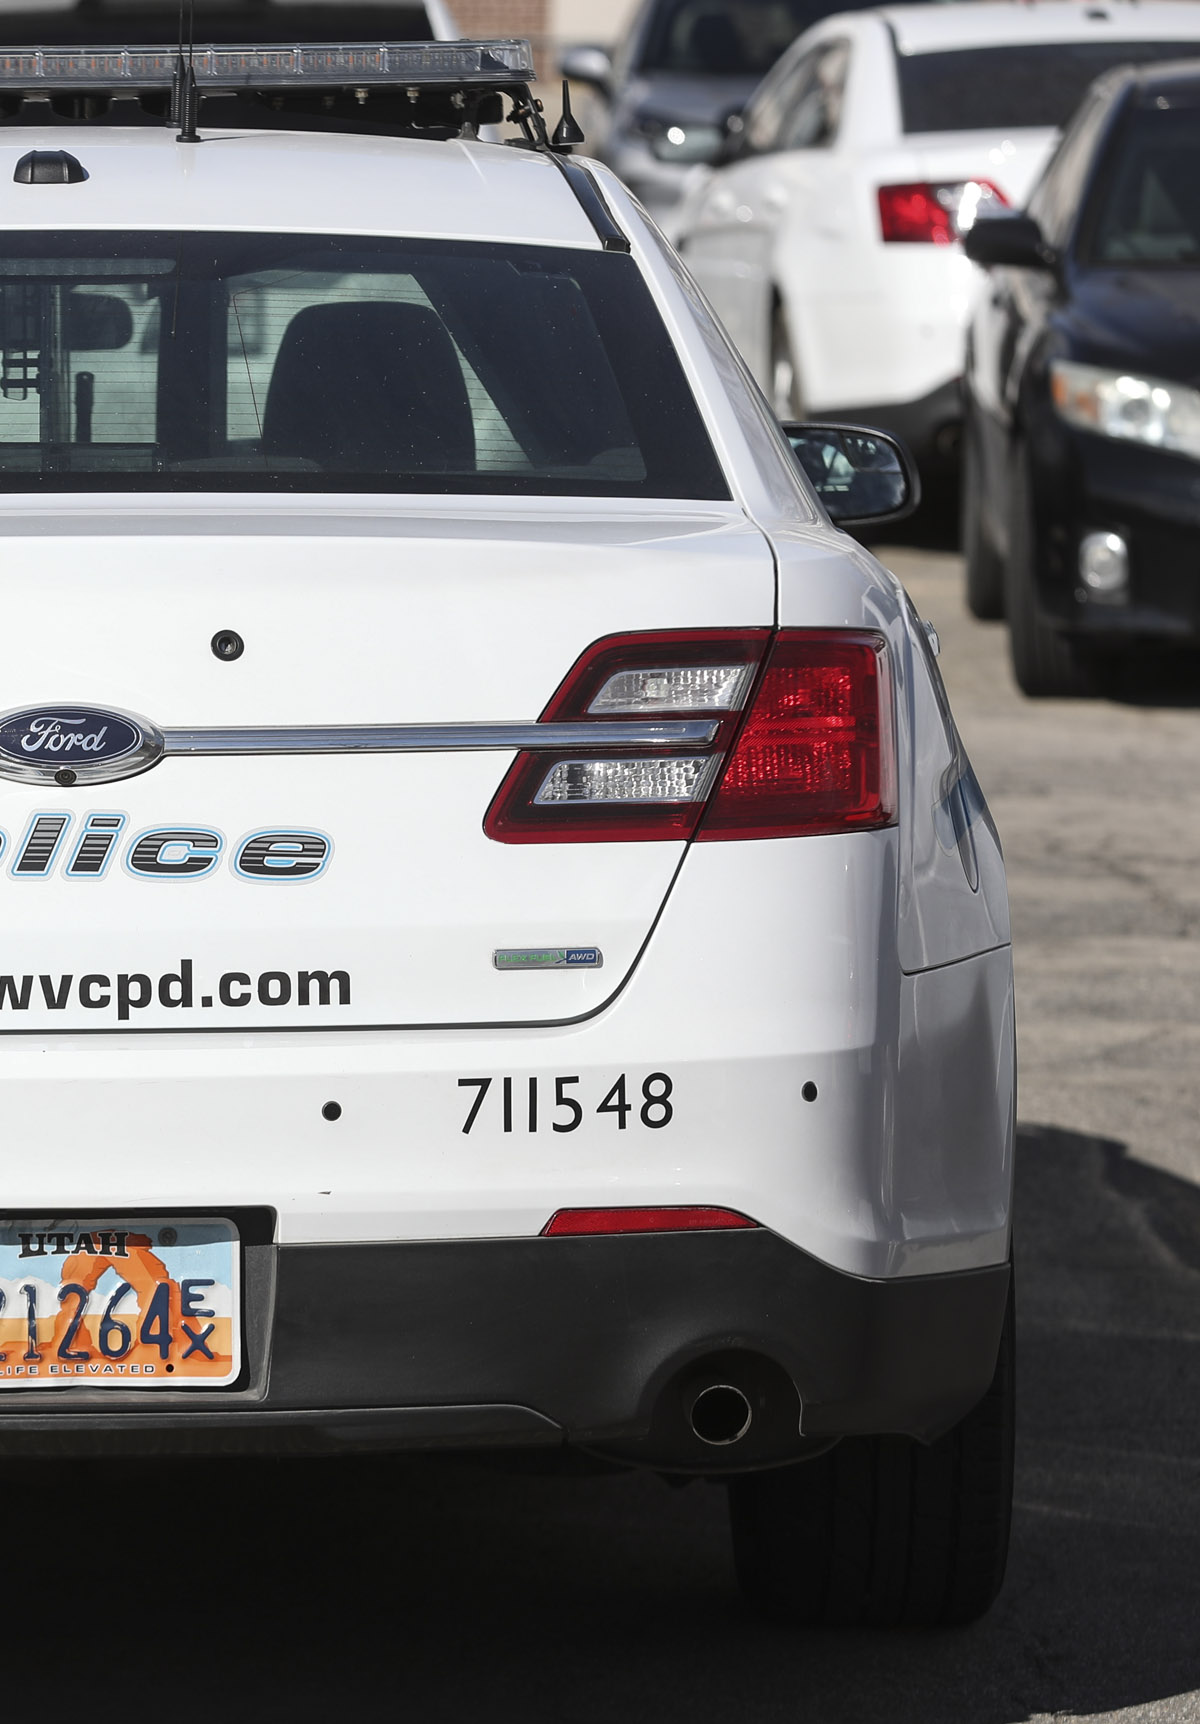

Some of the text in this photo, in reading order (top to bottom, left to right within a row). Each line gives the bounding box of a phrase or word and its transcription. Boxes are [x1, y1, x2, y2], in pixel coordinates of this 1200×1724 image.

[20, 716, 107, 752] Ford
[457, 1072, 674, 1135] 711548
[18, 1230, 130, 1259] UTAH
[49, 1364, 155, 1374] ELEVATED
